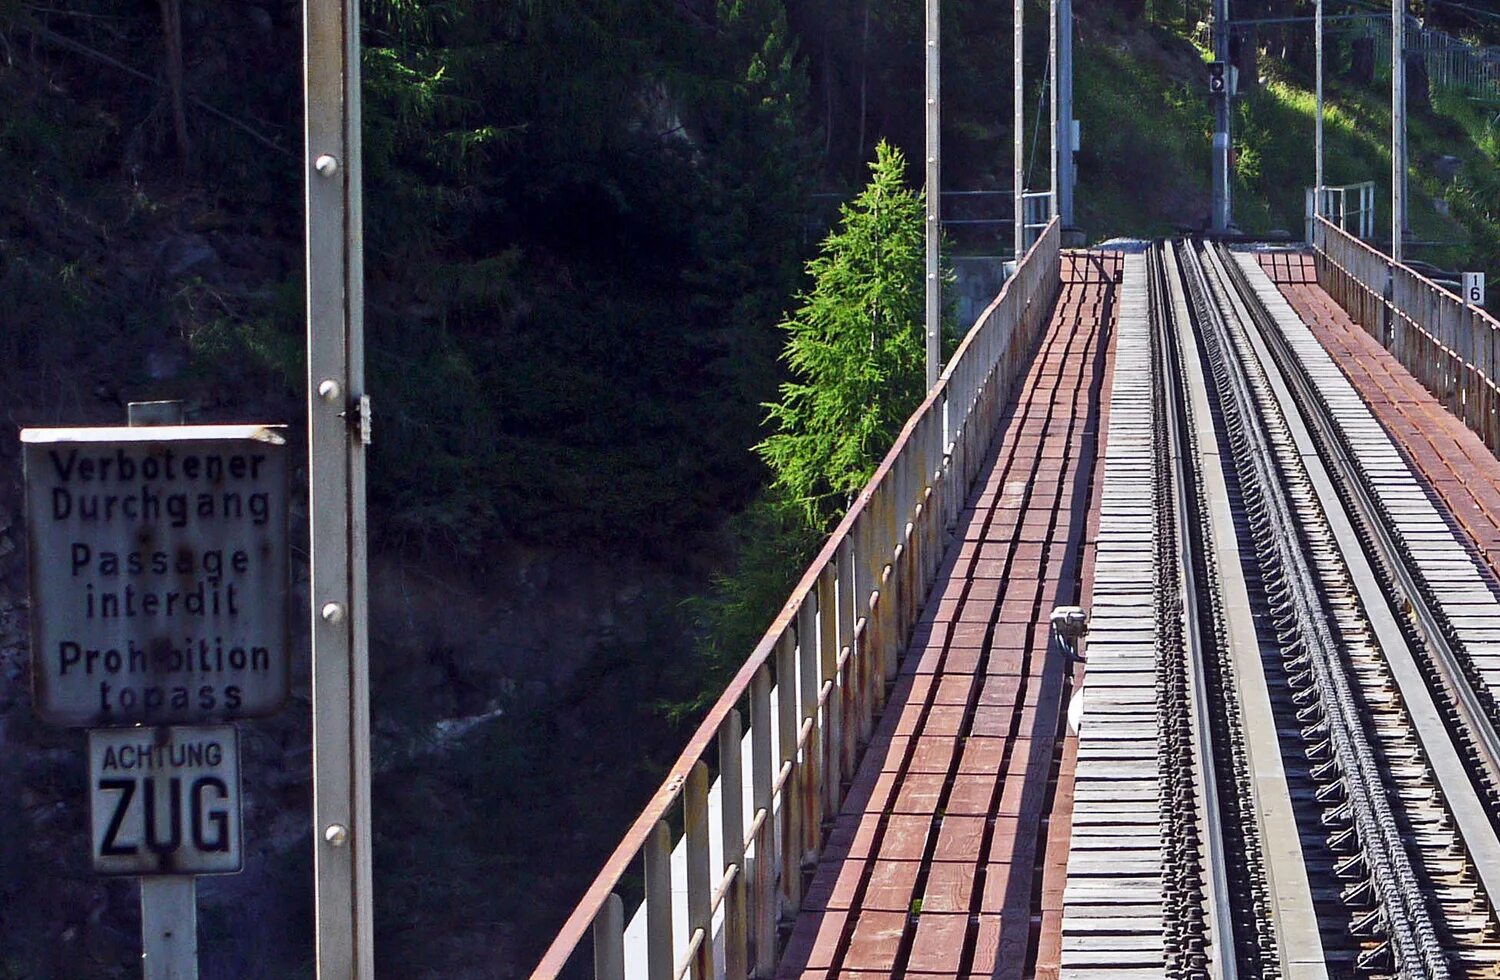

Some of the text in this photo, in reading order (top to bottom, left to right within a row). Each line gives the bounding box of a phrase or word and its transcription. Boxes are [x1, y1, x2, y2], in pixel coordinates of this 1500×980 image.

[1470, 286, 1480, 301] 6
[51, 450, 265, 482] Verbotener
[53, 486, 269, 527] Durchgang
[72, 543, 249, 583] Passage
[87, 583, 238, 618] interdit
[60, 638, 270, 675] Prohbition
[102, 743, 223, 770] ACHTUNG
[99, 777, 229, 855] ZUG
